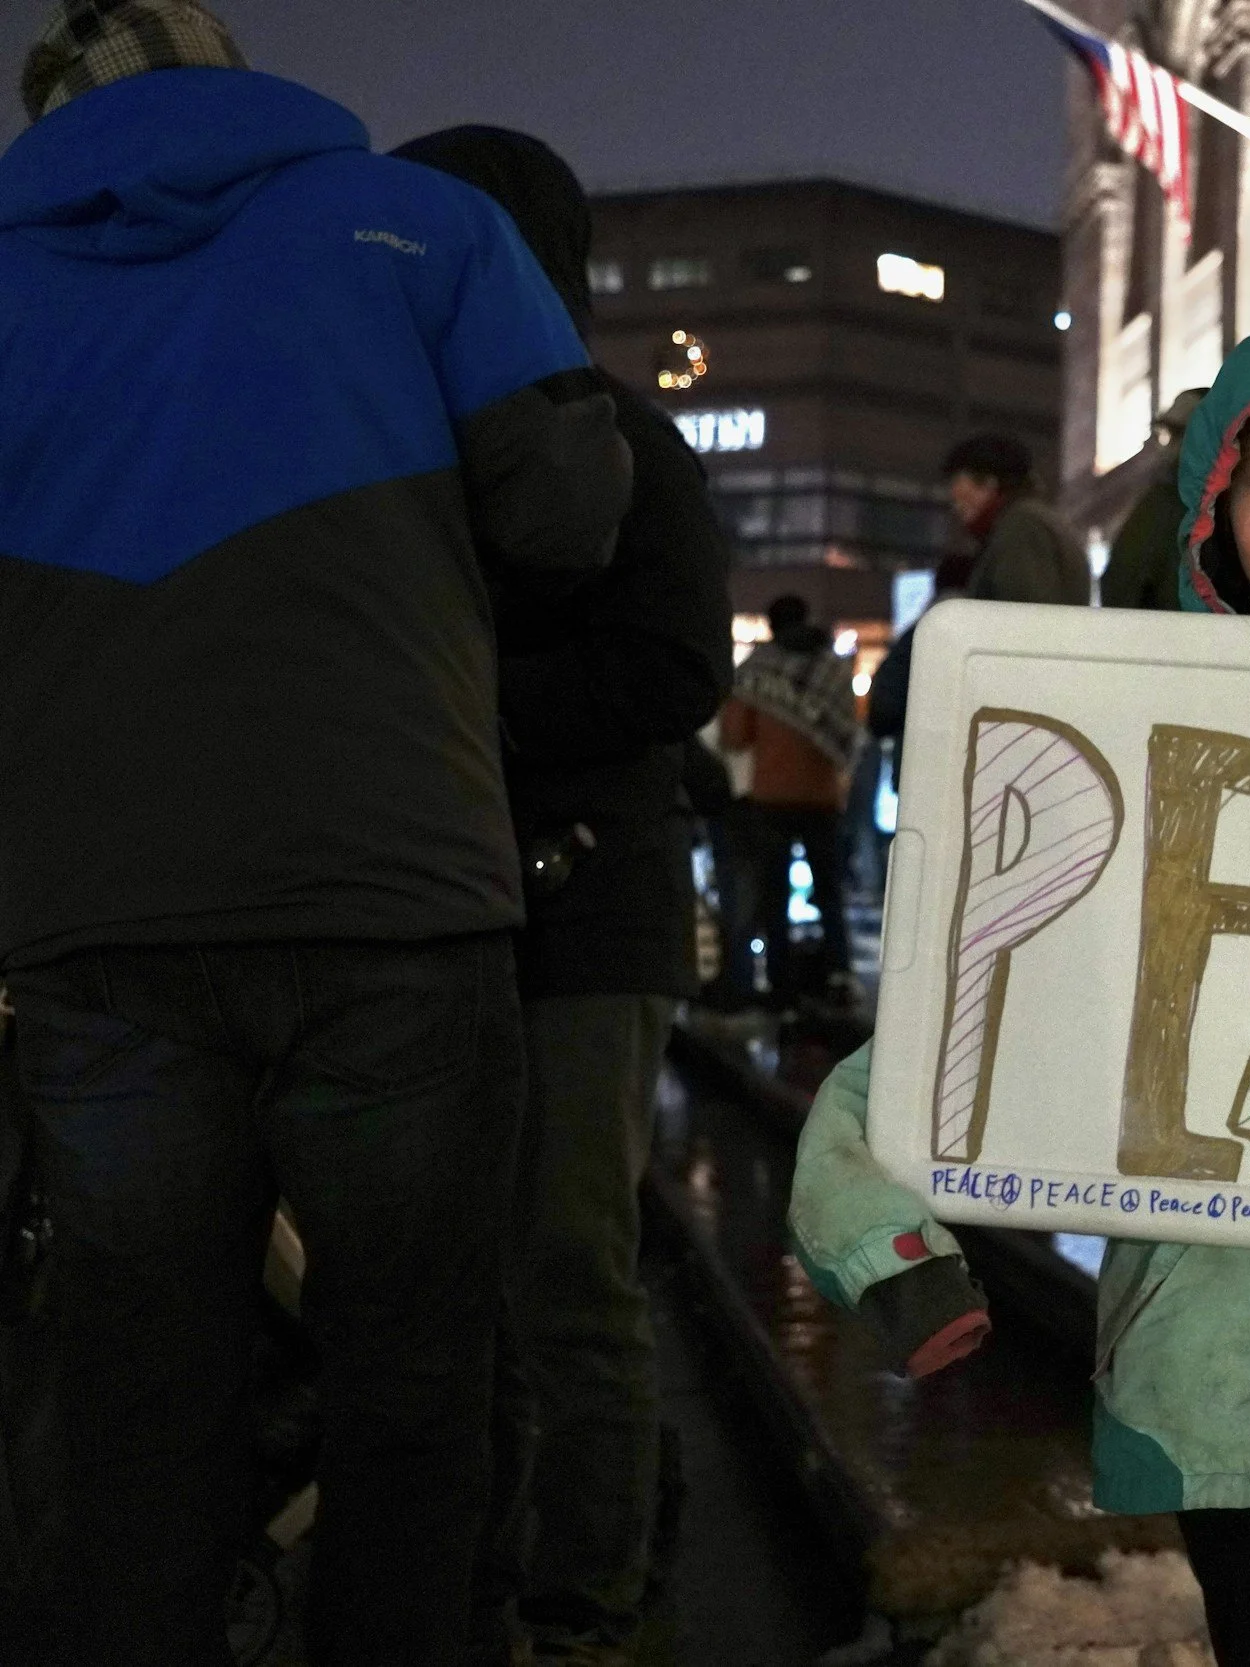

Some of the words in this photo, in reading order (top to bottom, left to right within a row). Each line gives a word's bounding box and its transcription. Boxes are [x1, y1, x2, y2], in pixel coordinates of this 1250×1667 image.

[354, 230, 427, 256] KARBON
[931, 1167, 996, 1199] PEACE
[1031, 1181, 1118, 1210] PEACE
[1149, 1189, 1203, 1214] Peace
